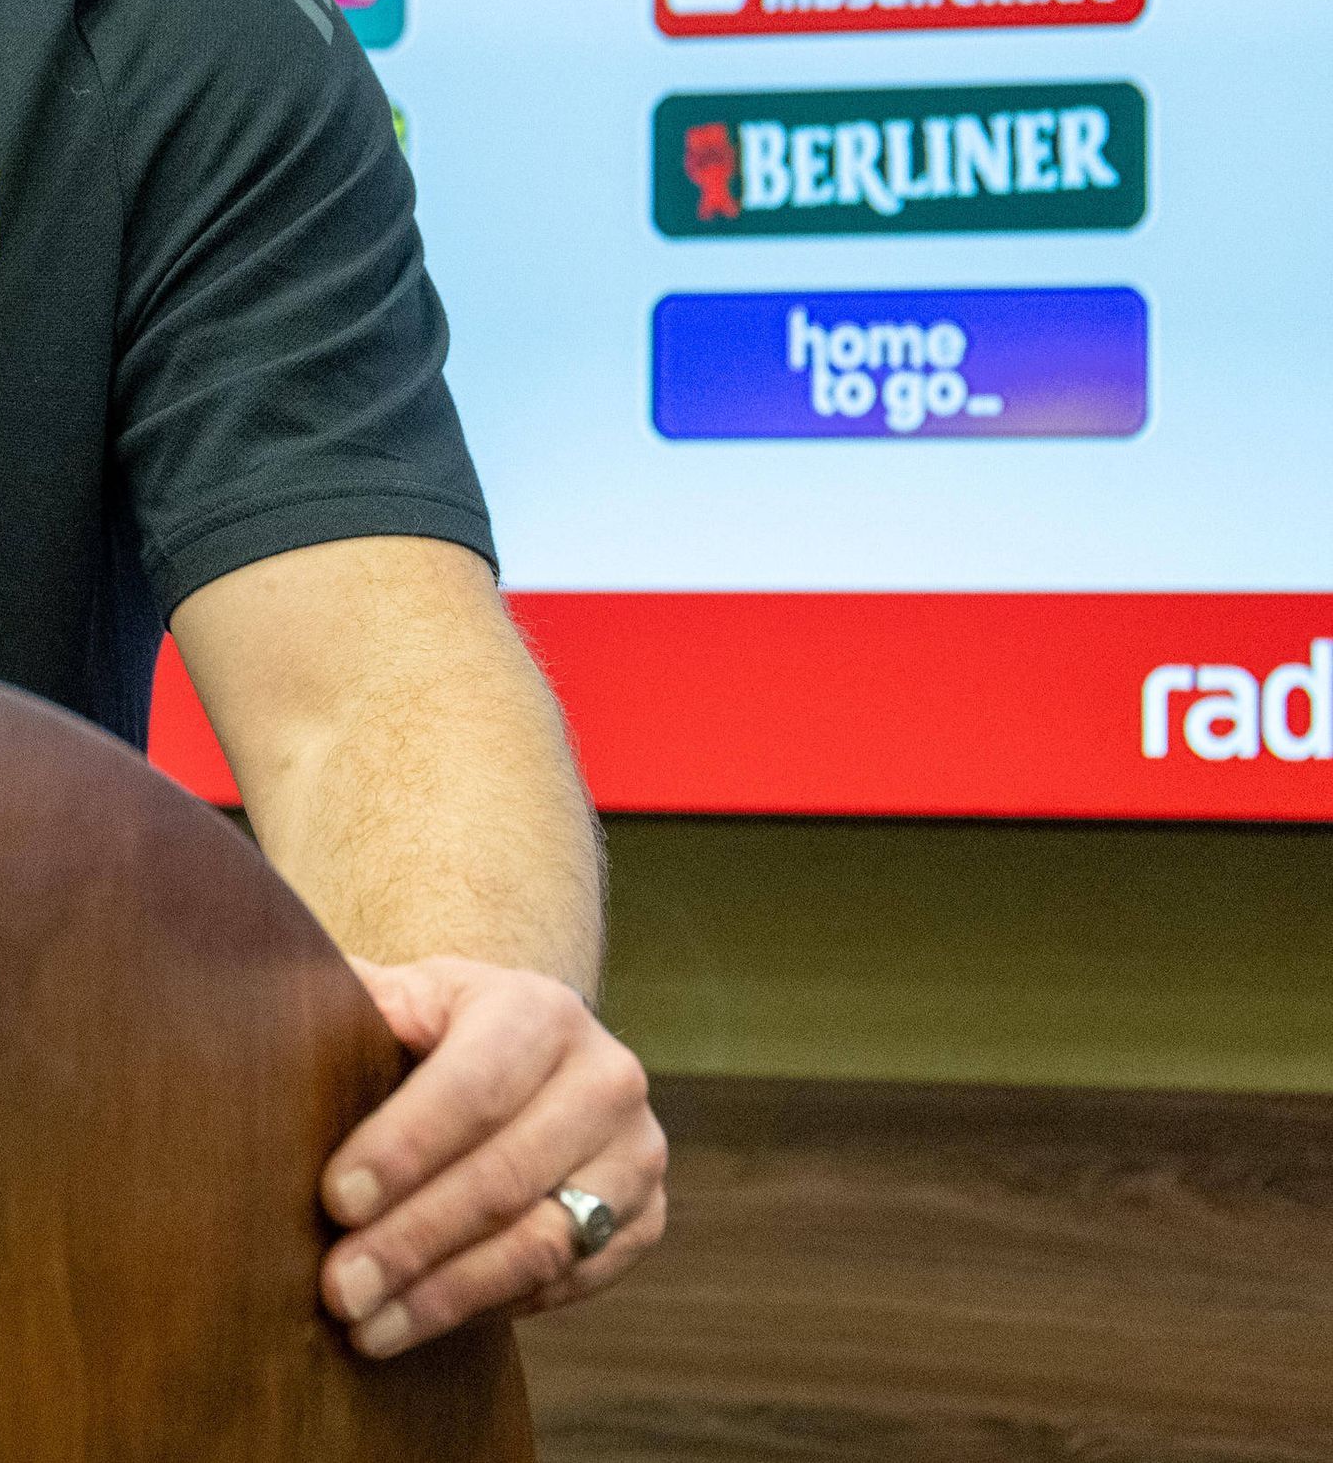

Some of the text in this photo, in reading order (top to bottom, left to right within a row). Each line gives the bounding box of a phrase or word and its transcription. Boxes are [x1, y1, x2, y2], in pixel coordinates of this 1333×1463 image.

[738, 106, 1120, 216] BERLINER
[787, 306, 967, 372] home
[812, 367, 876, 417] to
[1141, 636, 1333, 761] rad
